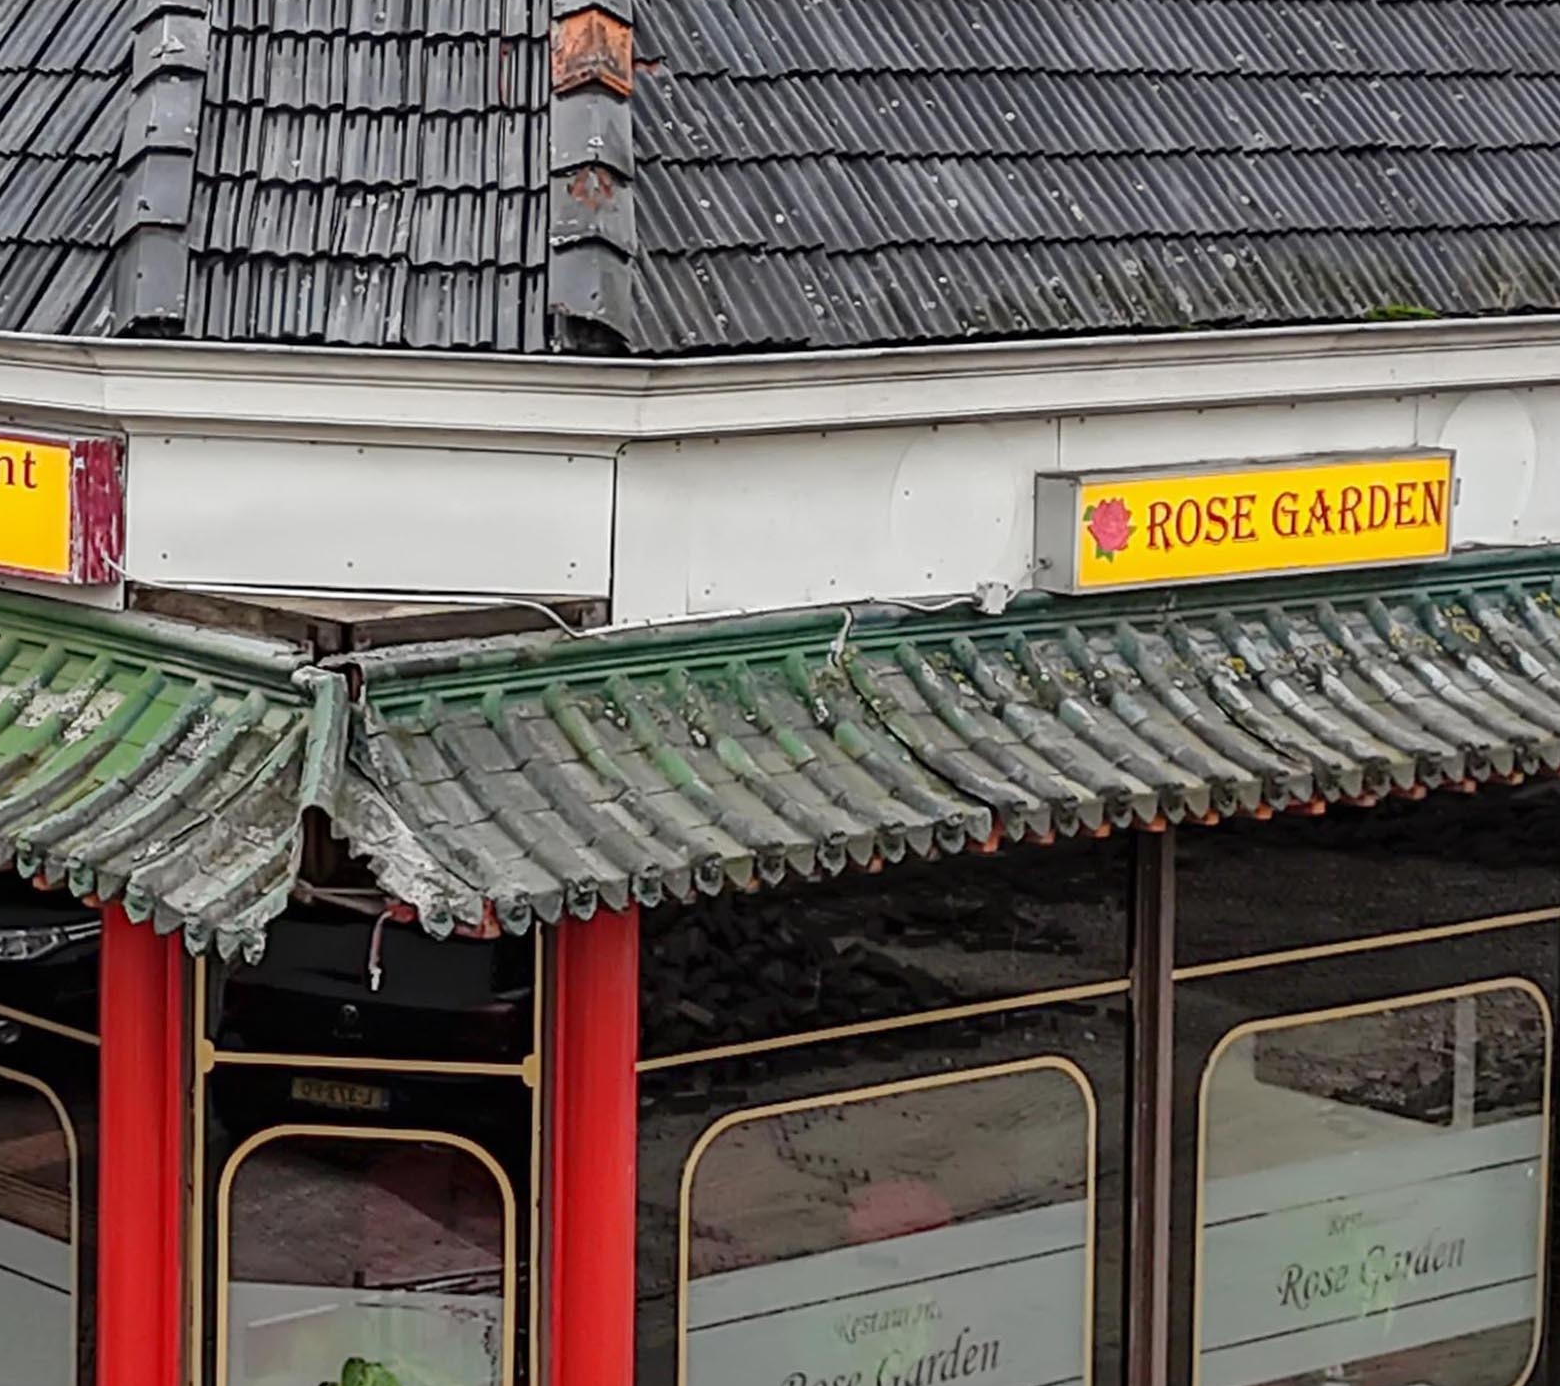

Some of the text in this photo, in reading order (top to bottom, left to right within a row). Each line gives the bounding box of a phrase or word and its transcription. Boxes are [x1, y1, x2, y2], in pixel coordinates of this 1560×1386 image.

[1147, 479, 1447, 552] ROSE GARDEN
[1277, 1263, 1350, 1311] Rose
